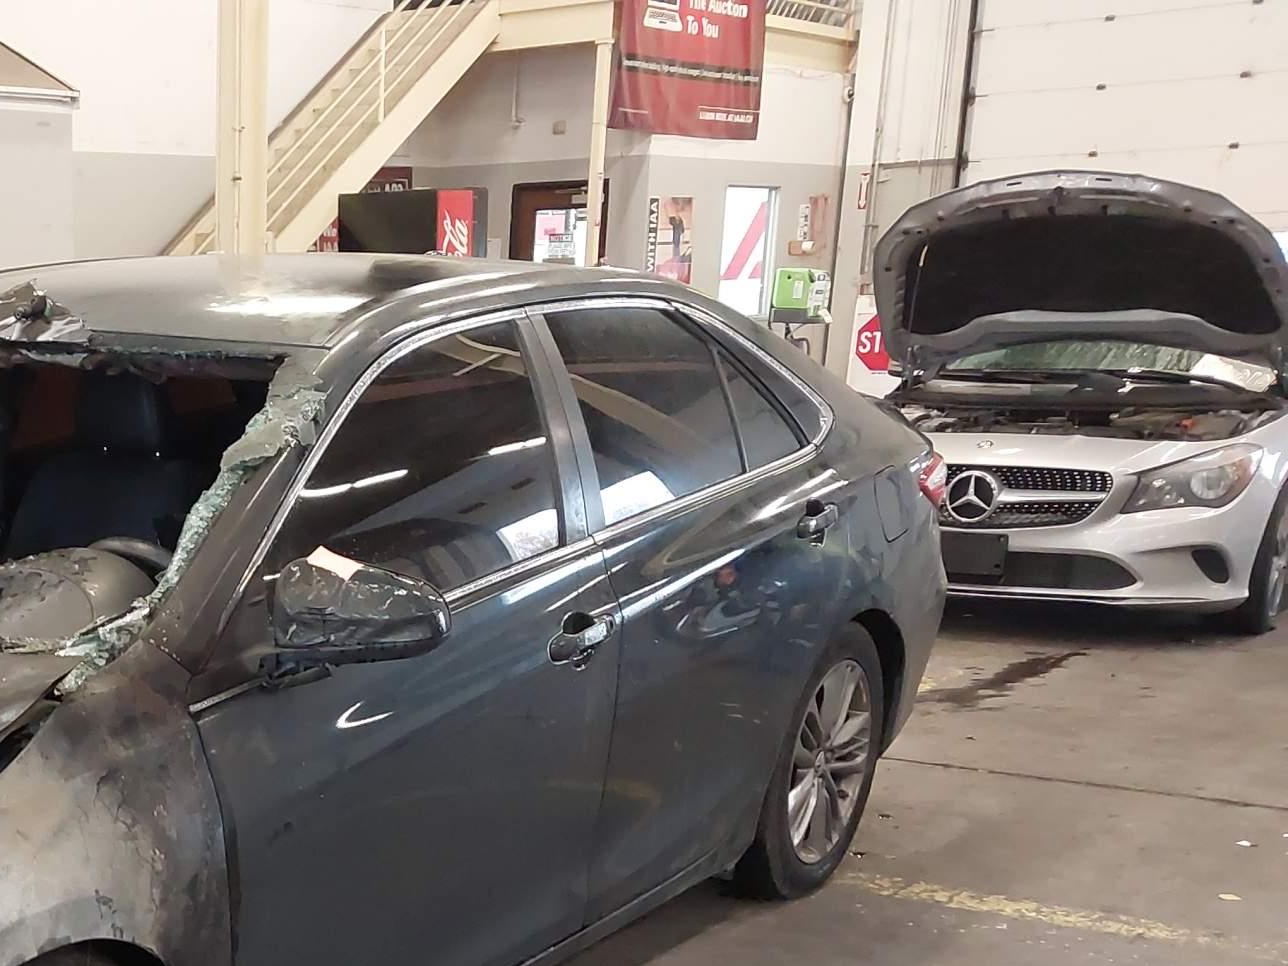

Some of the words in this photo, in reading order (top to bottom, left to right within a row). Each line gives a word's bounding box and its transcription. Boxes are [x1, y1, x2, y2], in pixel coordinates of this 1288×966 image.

[689, 0, 707, 12] The
[707, 0, 748, 18] Auction
[686, 15, 699, 36] To
[701, 17, 719, 39] You
[649, 201, 658, 228] IAA
[646, 232, 656, 272] WITH
[858, 331, 881, 353] ST
